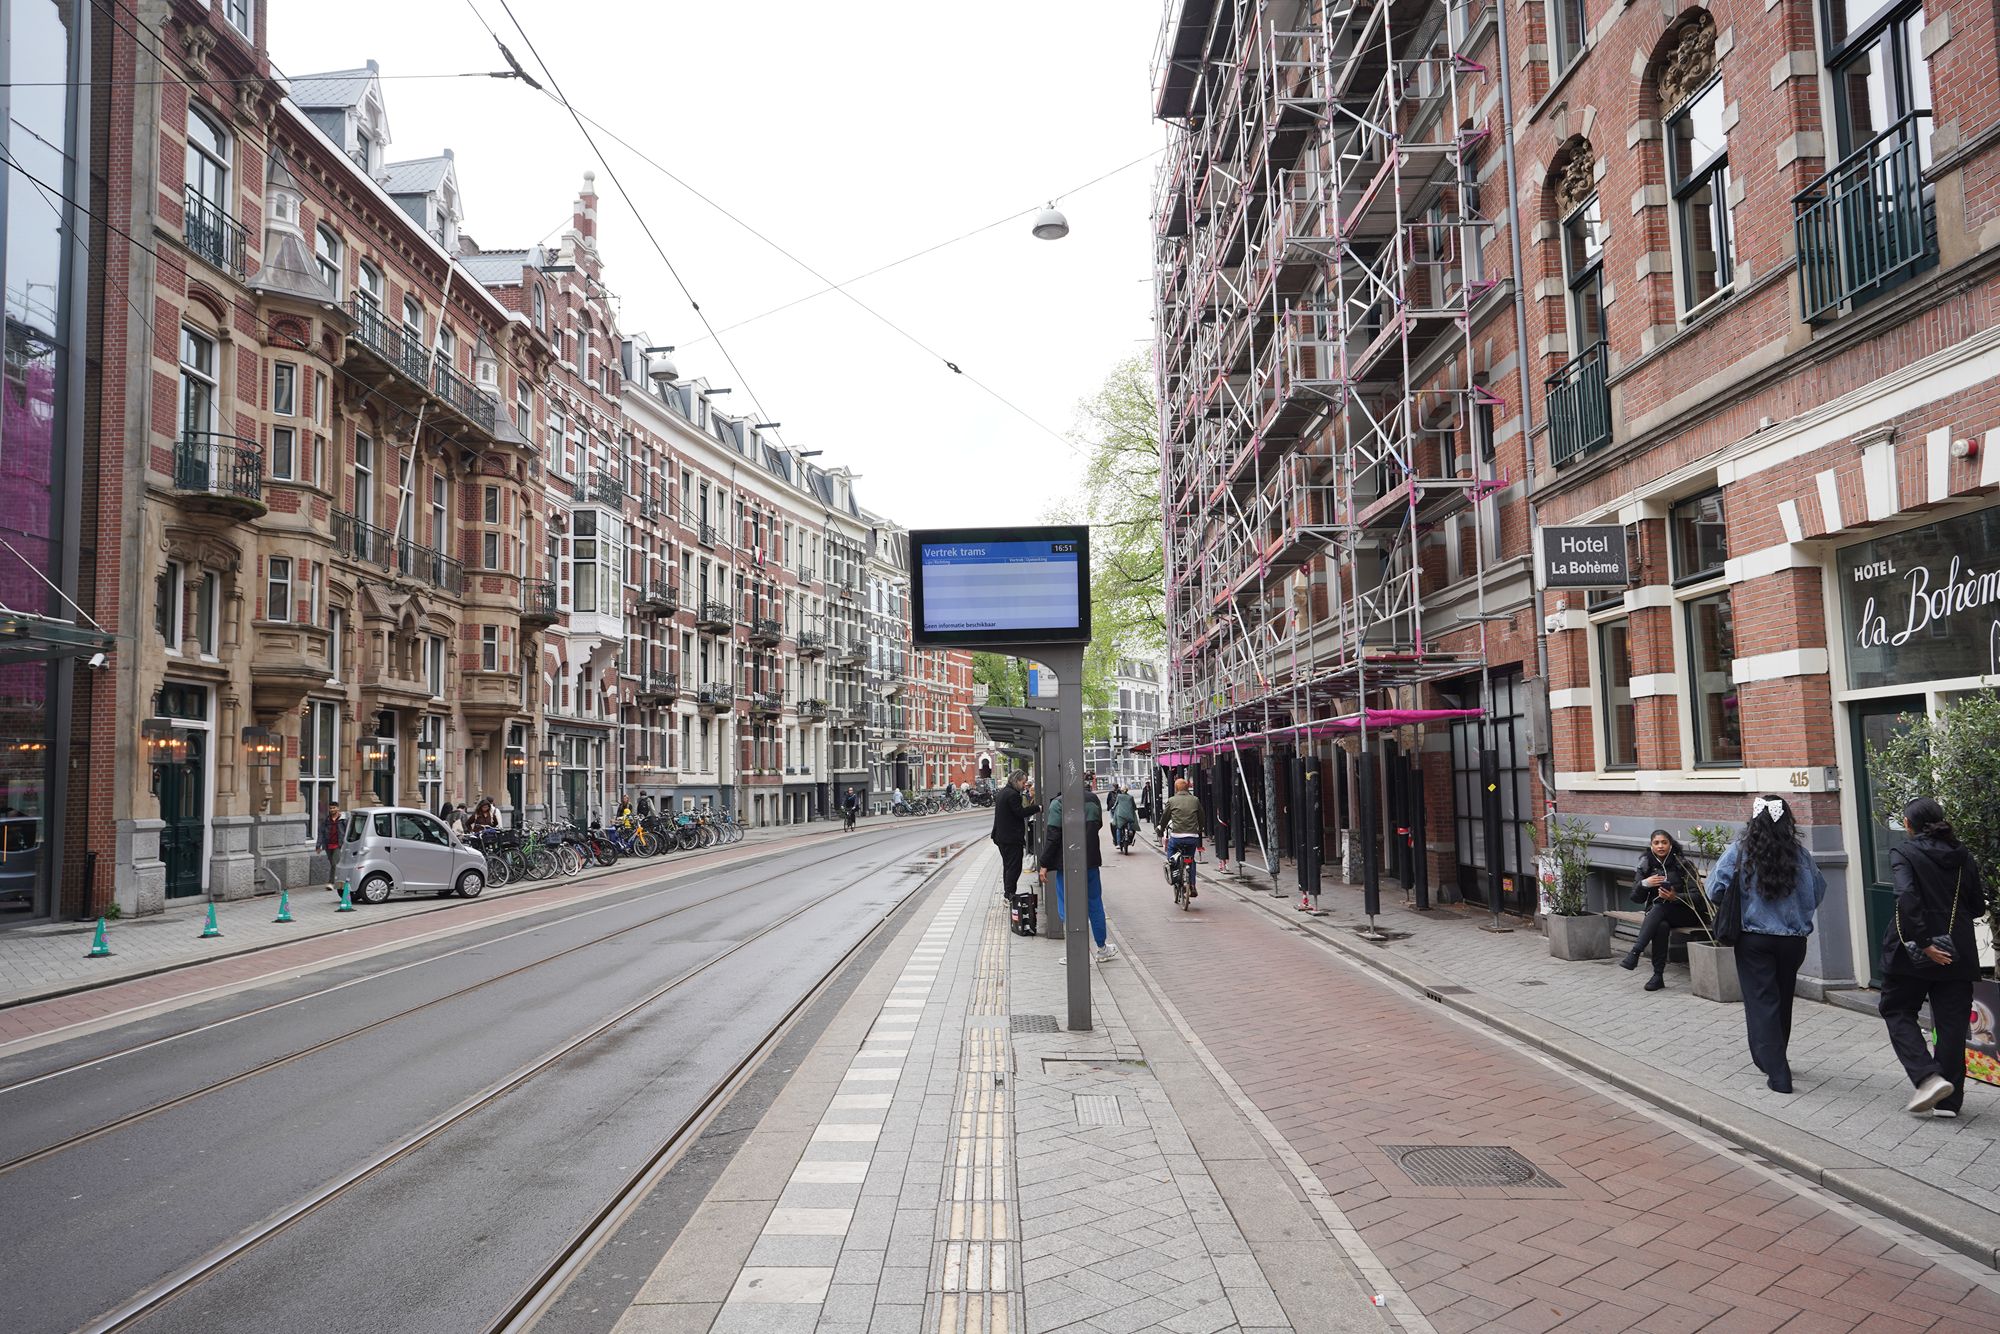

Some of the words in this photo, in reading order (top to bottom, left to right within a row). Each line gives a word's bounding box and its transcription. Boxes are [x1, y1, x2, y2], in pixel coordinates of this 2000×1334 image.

[924, 547, 958, 557] Vertrek
[960, 547, 986, 556] trams
[1055, 544, 1072, 552] 16:51
[1561, 536, 1608, 553] Hotel
[1551, 561, 1567, 575] La
[1569, 559, 1619, 574] Bohème
[1854, 560, 1896, 582] HOTEL
[1856, 597, 1889, 649] la
[1891, 555, 2000, 647] Bohèm
[1790, 771, 1809, 787] 415
